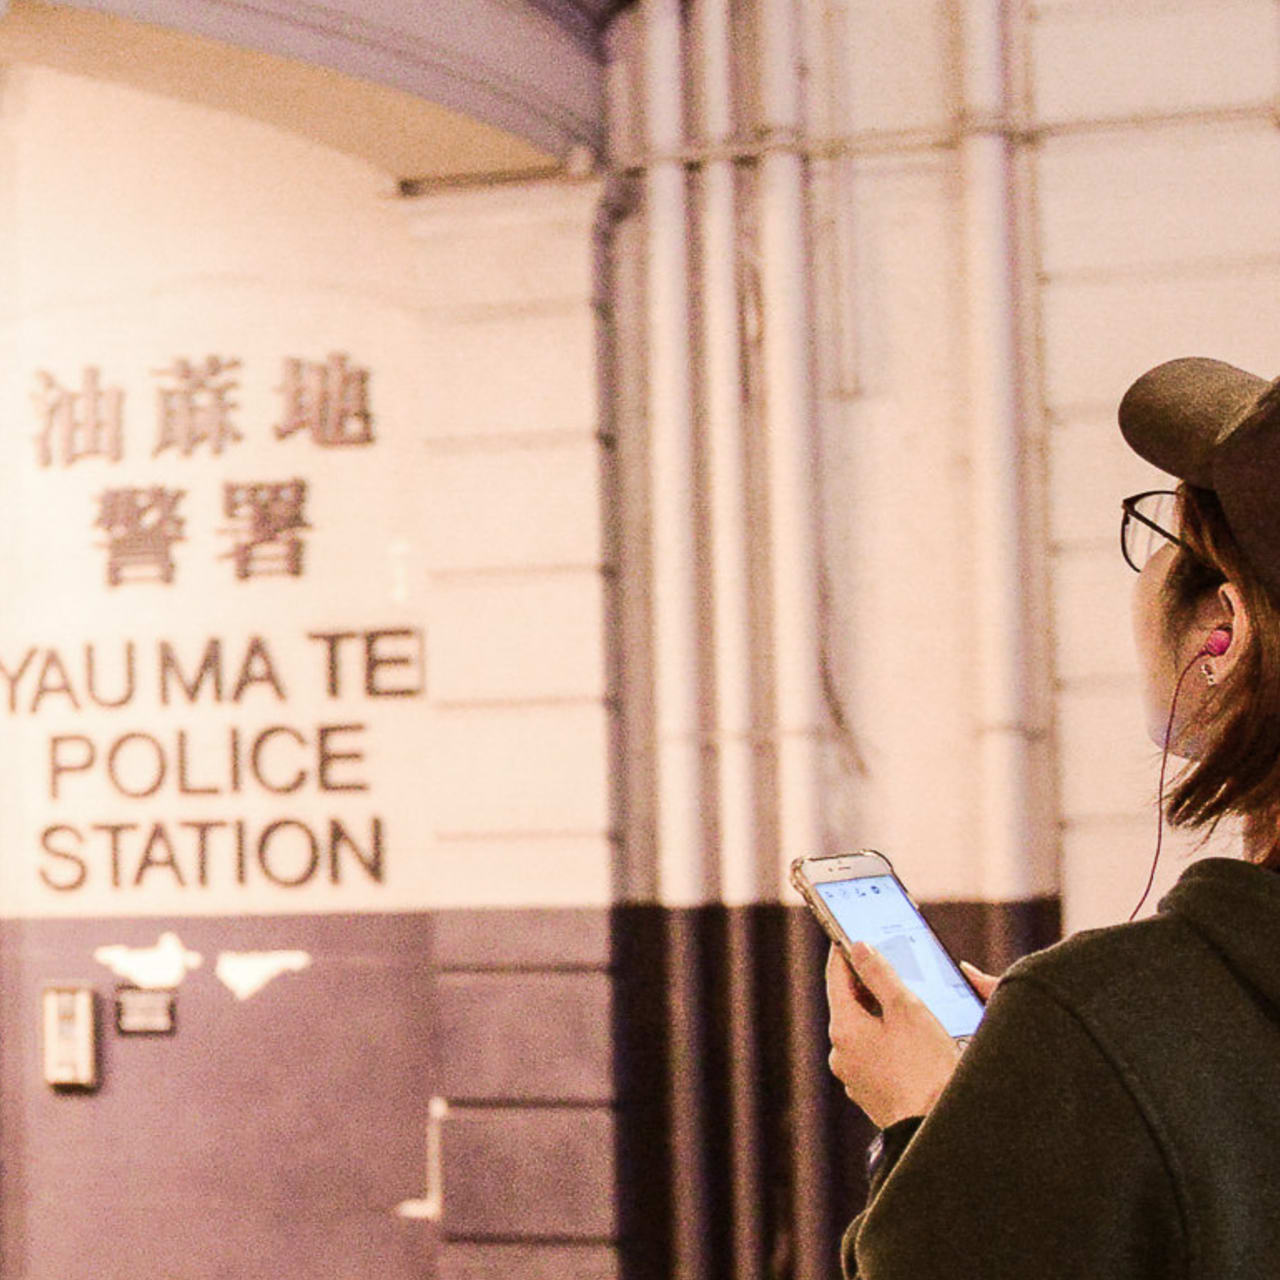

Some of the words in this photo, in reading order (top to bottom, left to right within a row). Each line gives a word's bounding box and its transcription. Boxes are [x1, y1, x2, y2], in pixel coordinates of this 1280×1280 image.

[91, 476, 315, 588] 警署
[158, 636, 286, 706] MA
[49, 723, 370, 799] POLICE
[38, 817, 386, 891] STATION
